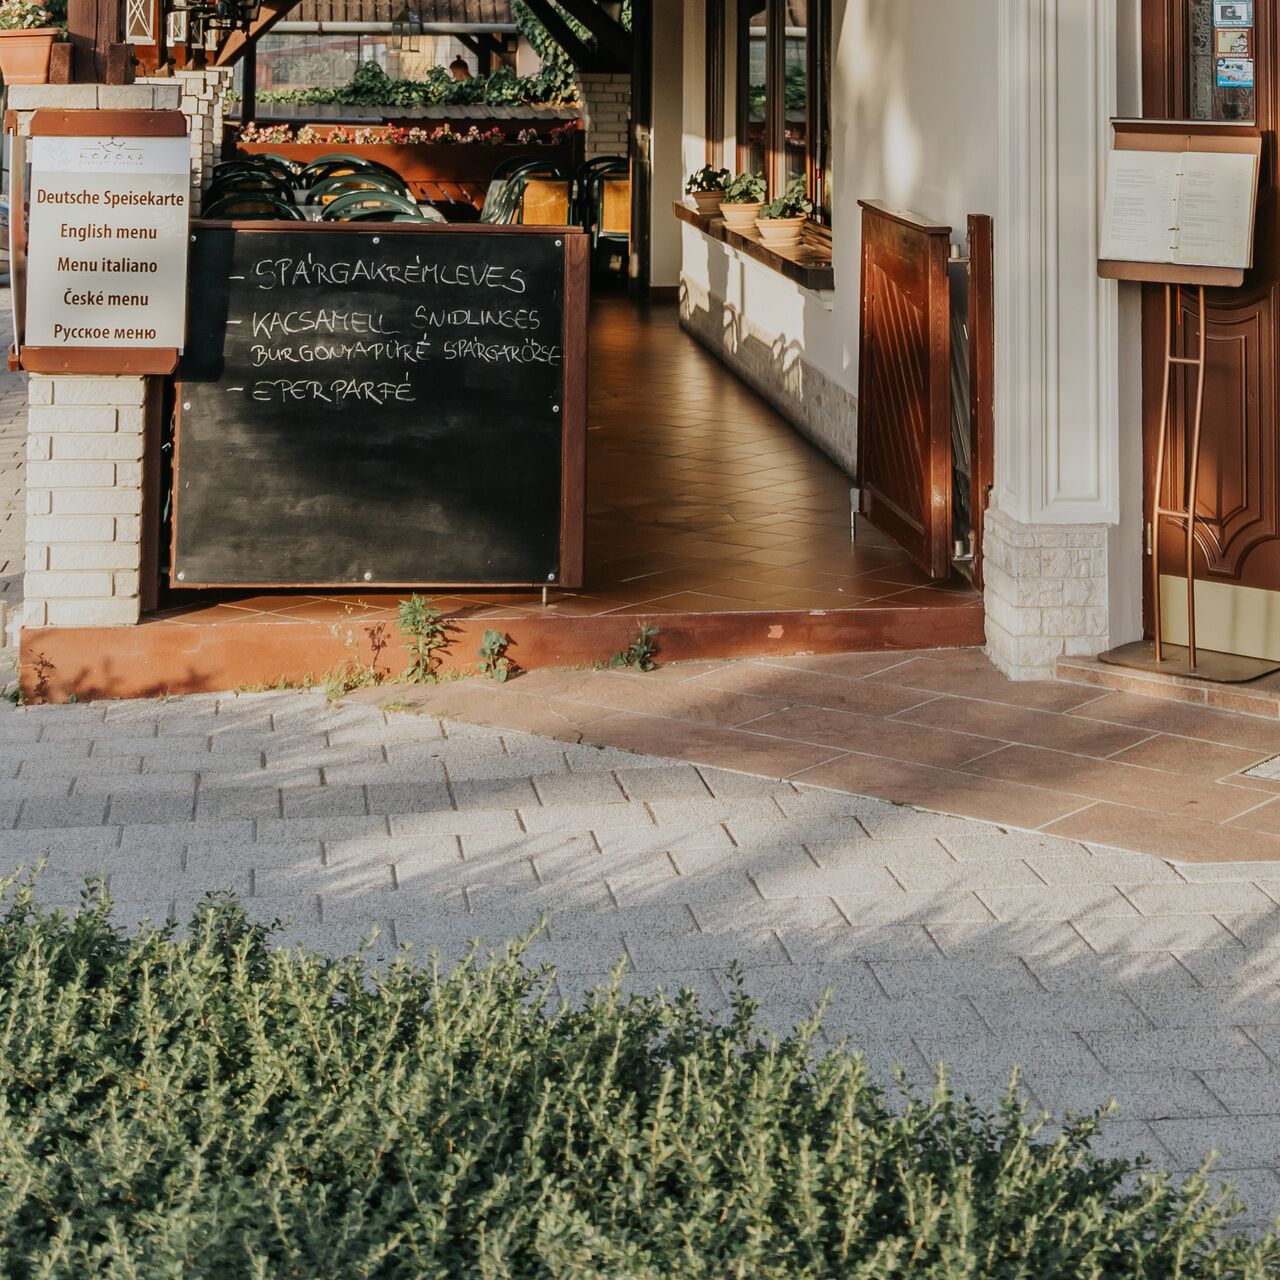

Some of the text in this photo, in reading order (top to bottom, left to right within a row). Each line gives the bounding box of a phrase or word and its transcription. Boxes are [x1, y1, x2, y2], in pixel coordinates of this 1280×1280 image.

[37, 189, 184, 208] Deutsche Speisekarte
[61, 224, 157, 241] English menu
[57, 257, 158, 273] Menu italiano
[256, 252, 526, 293] SPÁRGAKRÉMLEVES
[64, 288, 149, 306] České menu
[54, 324, 156, 342] Русское меню
